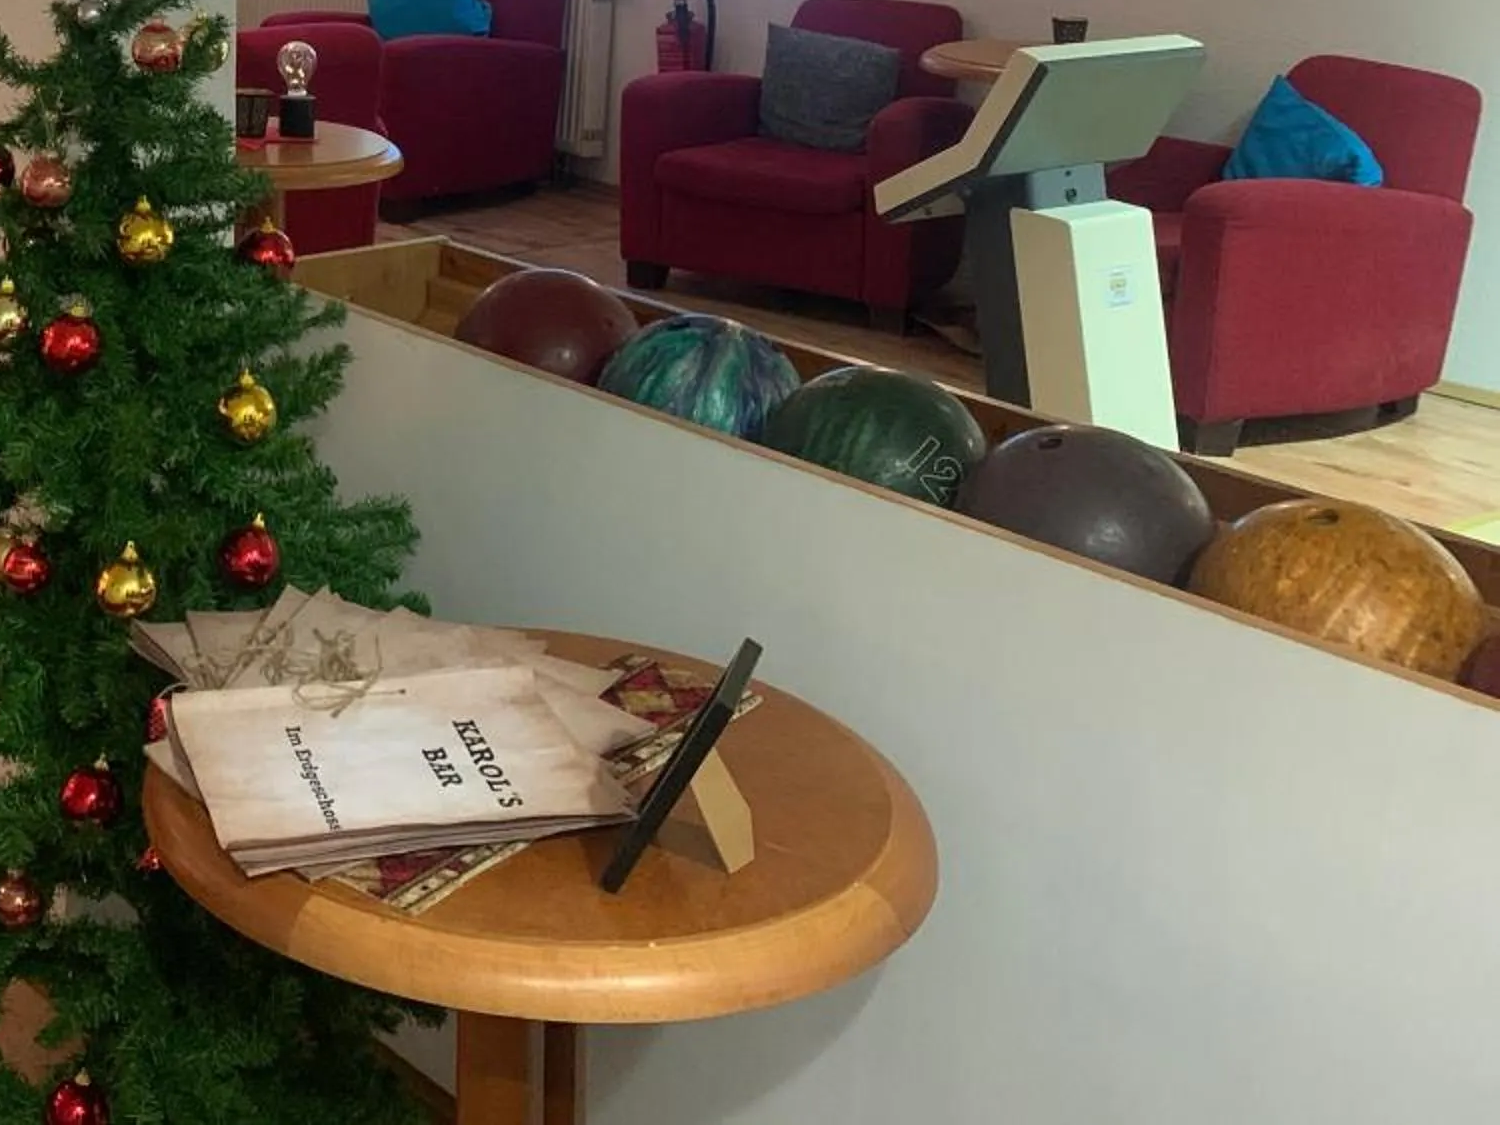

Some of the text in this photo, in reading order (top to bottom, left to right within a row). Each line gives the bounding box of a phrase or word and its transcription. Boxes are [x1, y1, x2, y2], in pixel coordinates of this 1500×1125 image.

[906, 435, 963, 504] 12
[285, 726, 342, 831] Im Erdgeschoss
[422, 747, 463, 788] BAR
